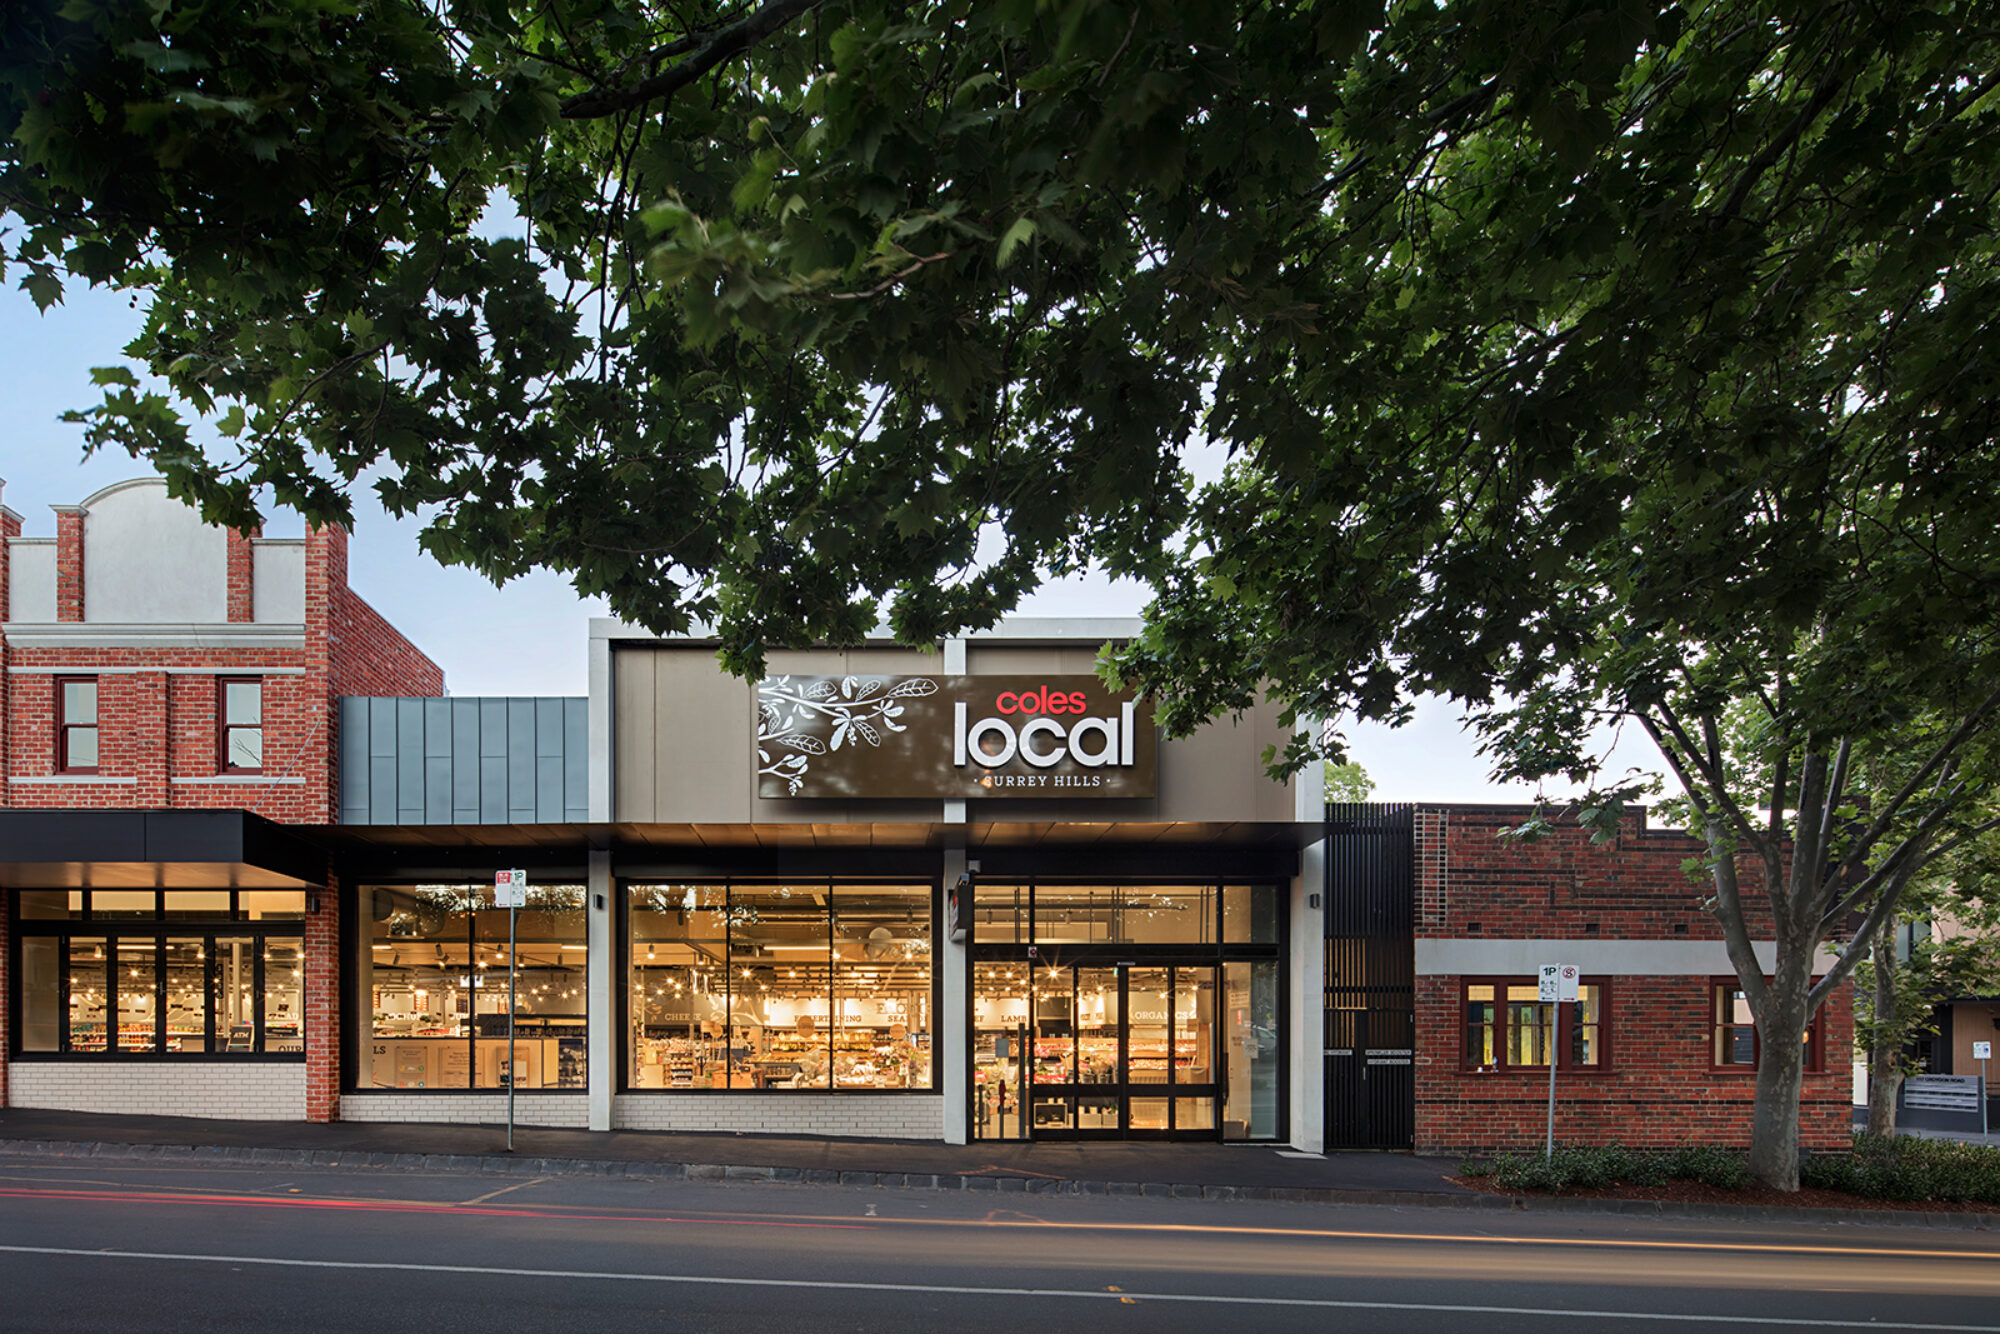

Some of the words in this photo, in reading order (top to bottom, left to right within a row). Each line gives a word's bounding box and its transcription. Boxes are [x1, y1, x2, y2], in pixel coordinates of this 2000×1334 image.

[996, 685, 1087, 715] coles
[953, 701, 1135, 768] local
[983, 775, 1048, 788] SURREY
[1054, 775, 1101, 788] HILLS
[514, 872, 524, 881] 1P
[1543, 967, 1557, 976] 1P
[1135, 1011, 1188, 1020] ORGANCS
[233, 1031, 250, 1039] ATM
